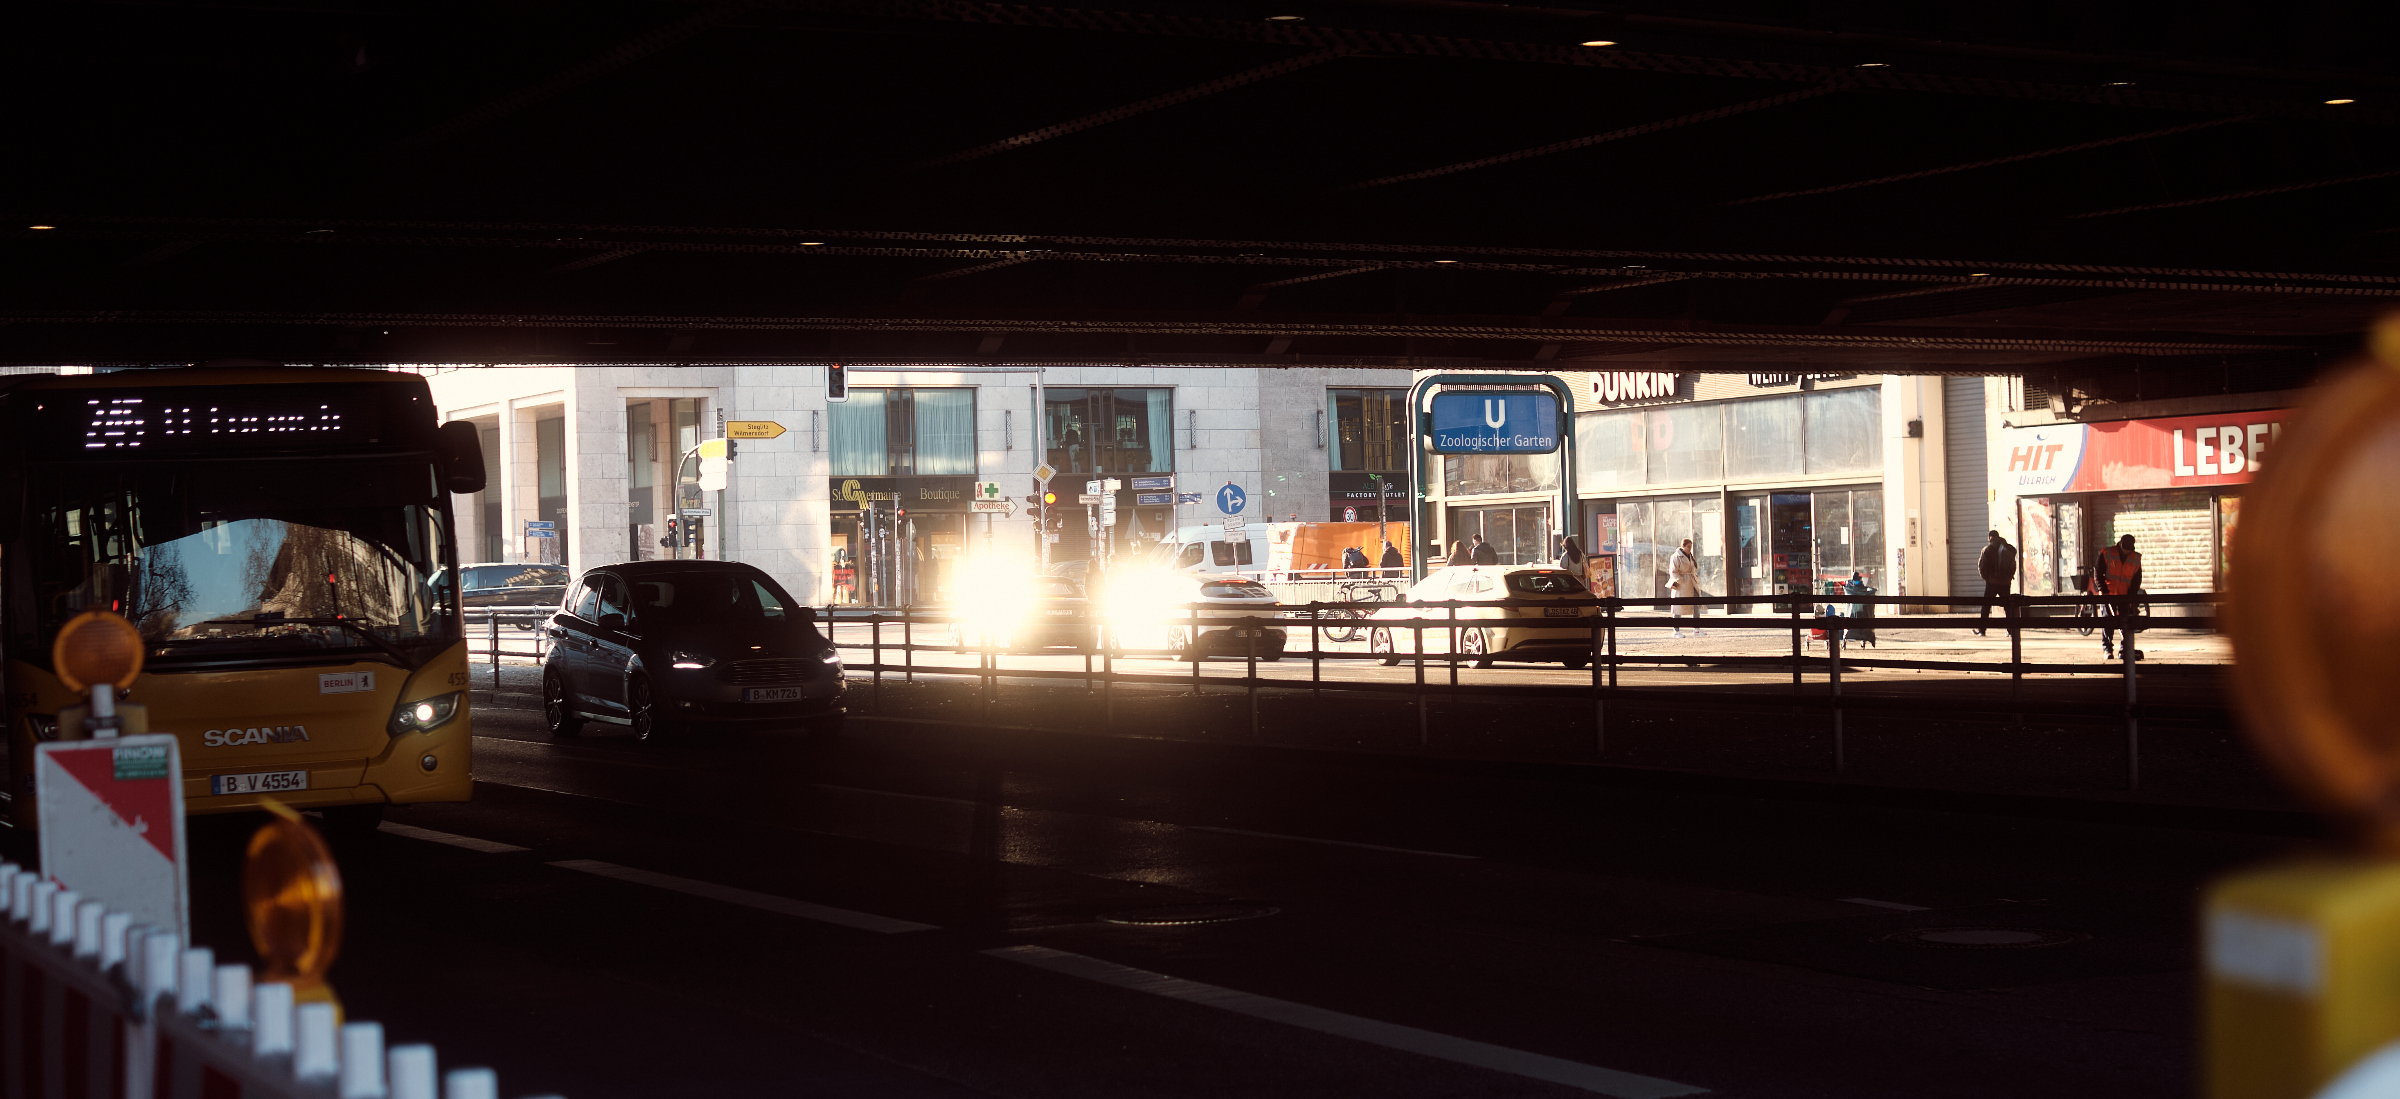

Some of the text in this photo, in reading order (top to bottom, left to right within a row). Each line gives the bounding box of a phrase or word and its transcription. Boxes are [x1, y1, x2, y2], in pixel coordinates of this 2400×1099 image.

[1485, 399, 1506, 429] U
[1440, 434, 1552, 451] Zoologischer Garten
[2173, 423, 2283, 477] LEBE
[2008, 443, 2064, 472] HIT
[920, 488, 960, 502] Boutique
[974, 502, 1010, 511] Apotheke
[324, 678, 353, 688] BERLIN
[753, 688, 798, 700] B KM 726
[203, 725, 310, 747] SCANIA
[226, 772, 301, 792] B V 4554
